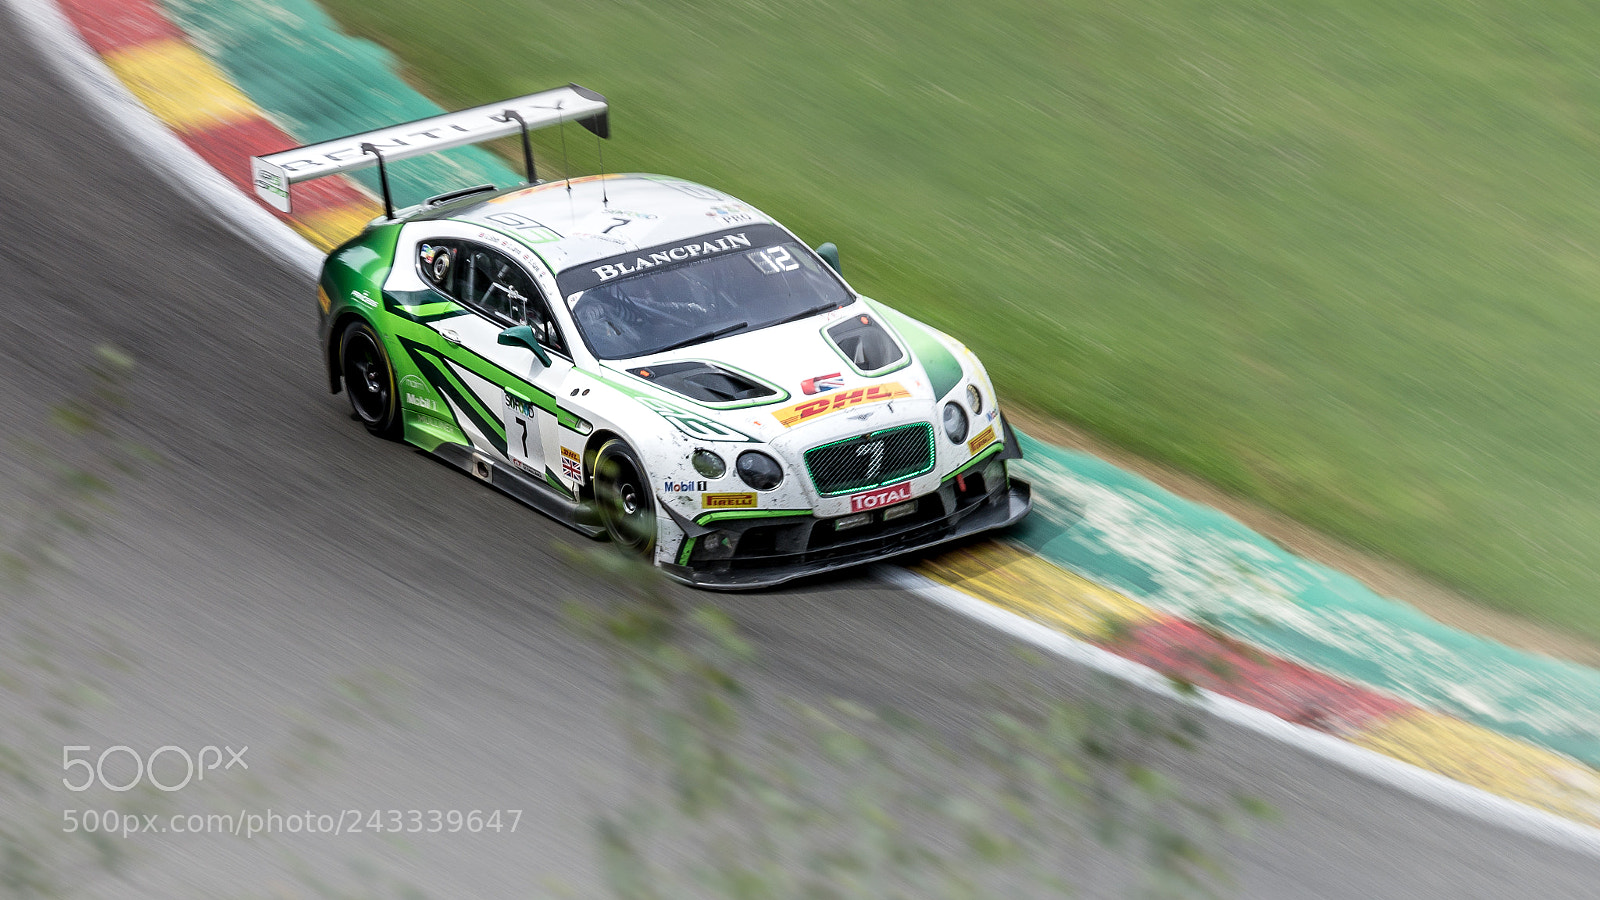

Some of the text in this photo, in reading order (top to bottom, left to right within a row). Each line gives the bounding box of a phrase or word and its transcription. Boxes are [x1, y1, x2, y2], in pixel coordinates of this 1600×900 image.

[721, 213, 752, 225] PRO
[592, 233, 752, 282] BLANCPAIN
[759, 245, 800, 273] 12
[794, 386, 892, 419] DHL
[515, 416, 529, 459] 7
[562, 448, 578, 461] DHL
[664, 480, 707, 492] Mobil 1
[706, 494, 753, 506] PIRELLI
[851, 488, 911, 510] TOTAL
